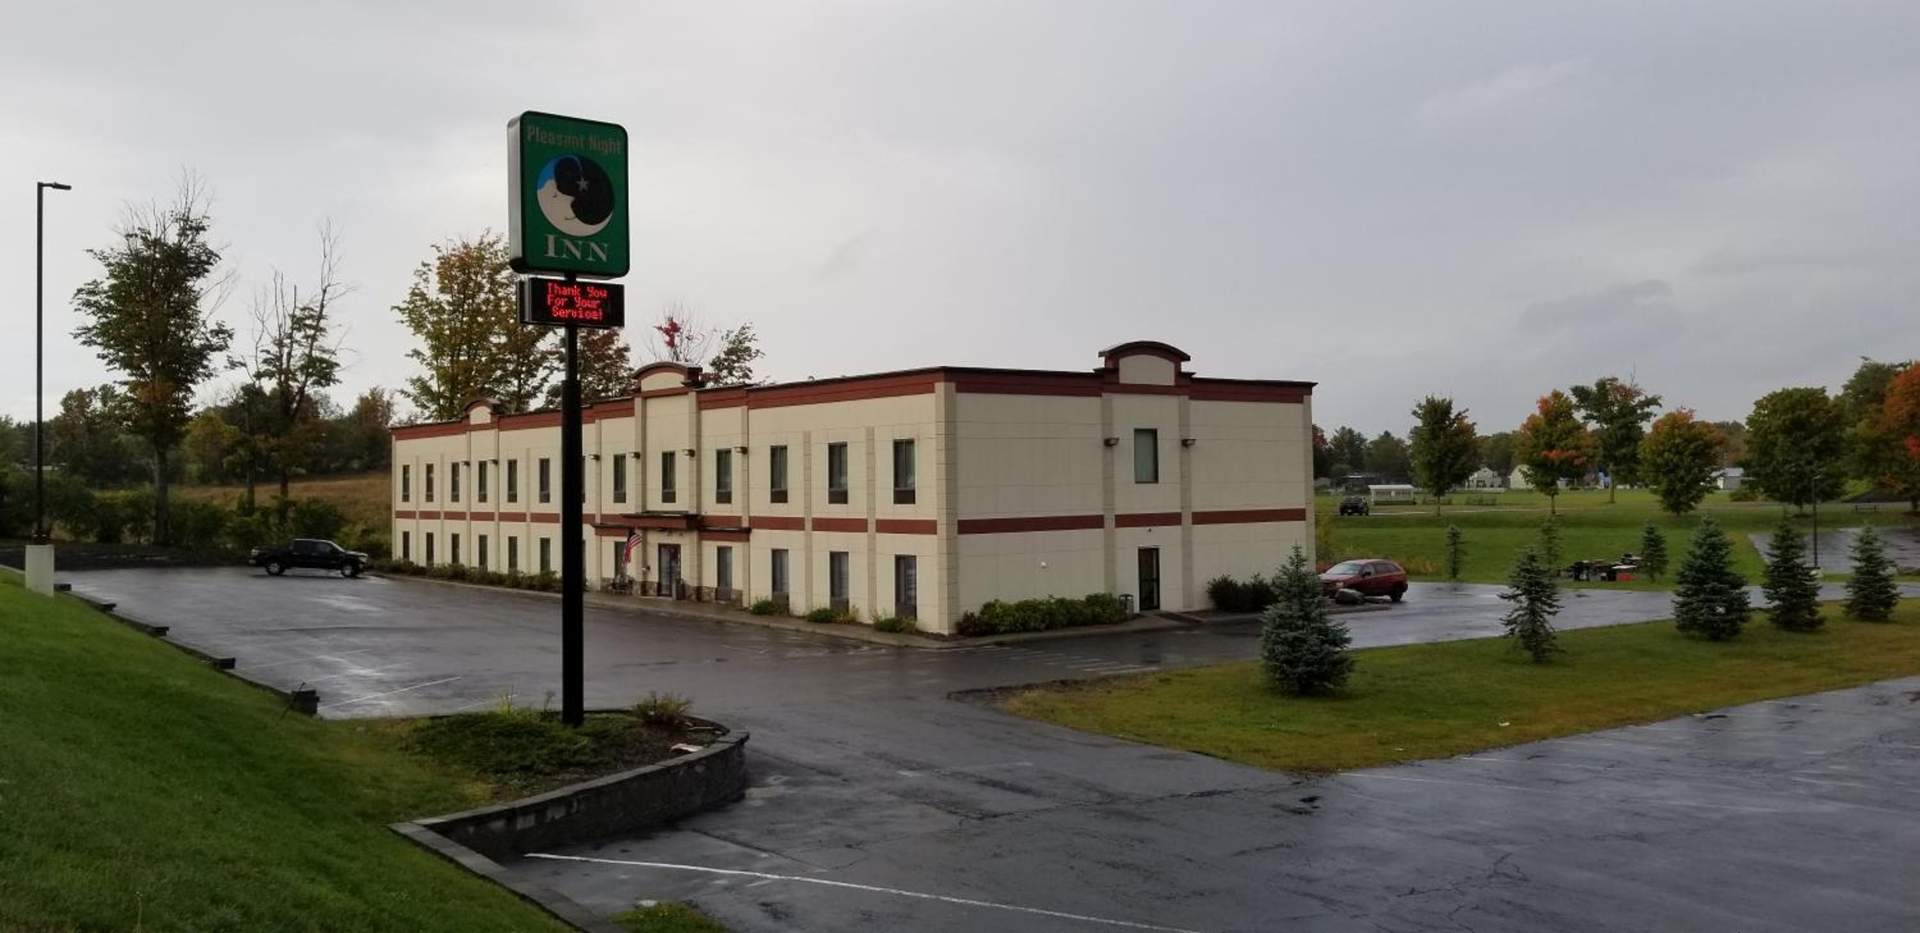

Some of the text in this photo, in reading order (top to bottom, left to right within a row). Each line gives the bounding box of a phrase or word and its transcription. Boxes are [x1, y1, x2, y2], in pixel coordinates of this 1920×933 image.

[527, 125, 621, 155] Pleasant Night
[547, 282, 608, 298] Thank You
[547, 294, 600, 308] For Your
[551, 306, 603, 320] Service!
